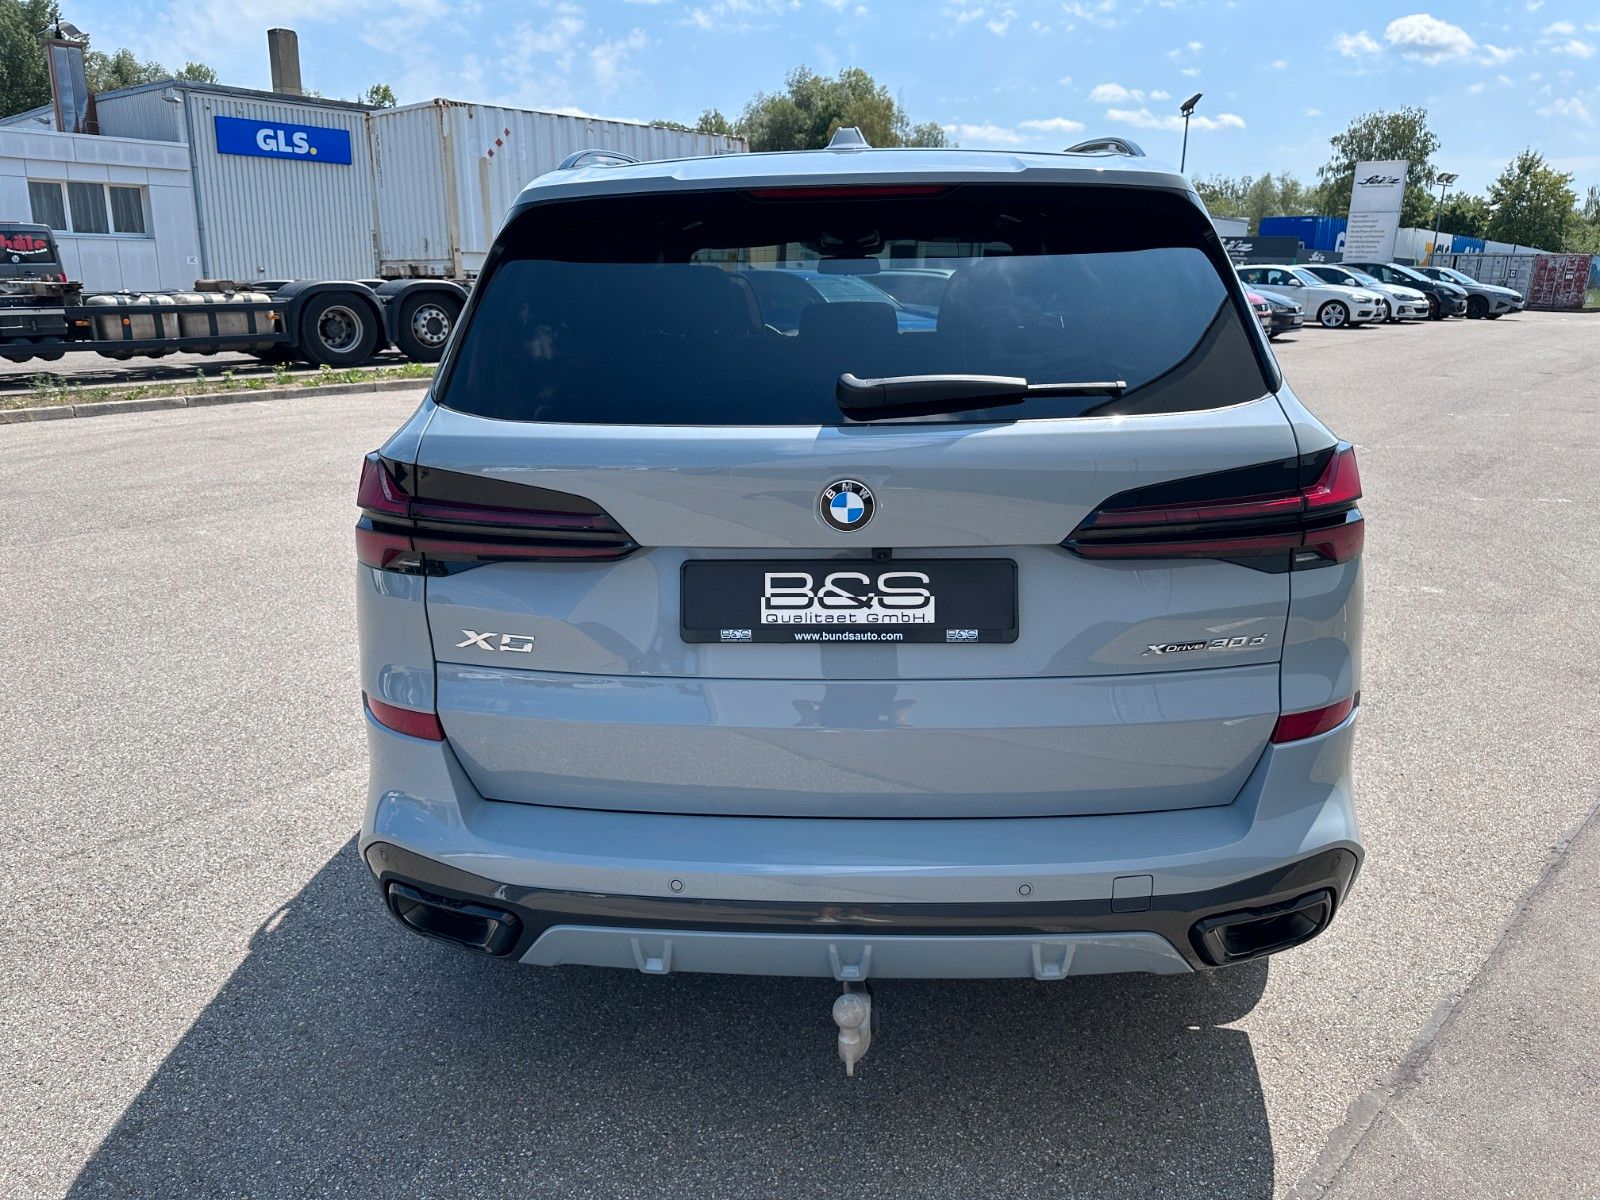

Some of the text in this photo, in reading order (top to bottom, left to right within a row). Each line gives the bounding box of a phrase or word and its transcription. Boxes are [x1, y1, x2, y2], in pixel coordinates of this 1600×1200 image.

[256, 128, 318, 155] GLS.
[825, 481, 870, 500] BMW
[764, 571, 930, 610] B&S
[765, 611, 857, 624] Qualitaet
[454, 628, 535, 653] X5
[794, 630, 903, 642] www.bundsauto.com
